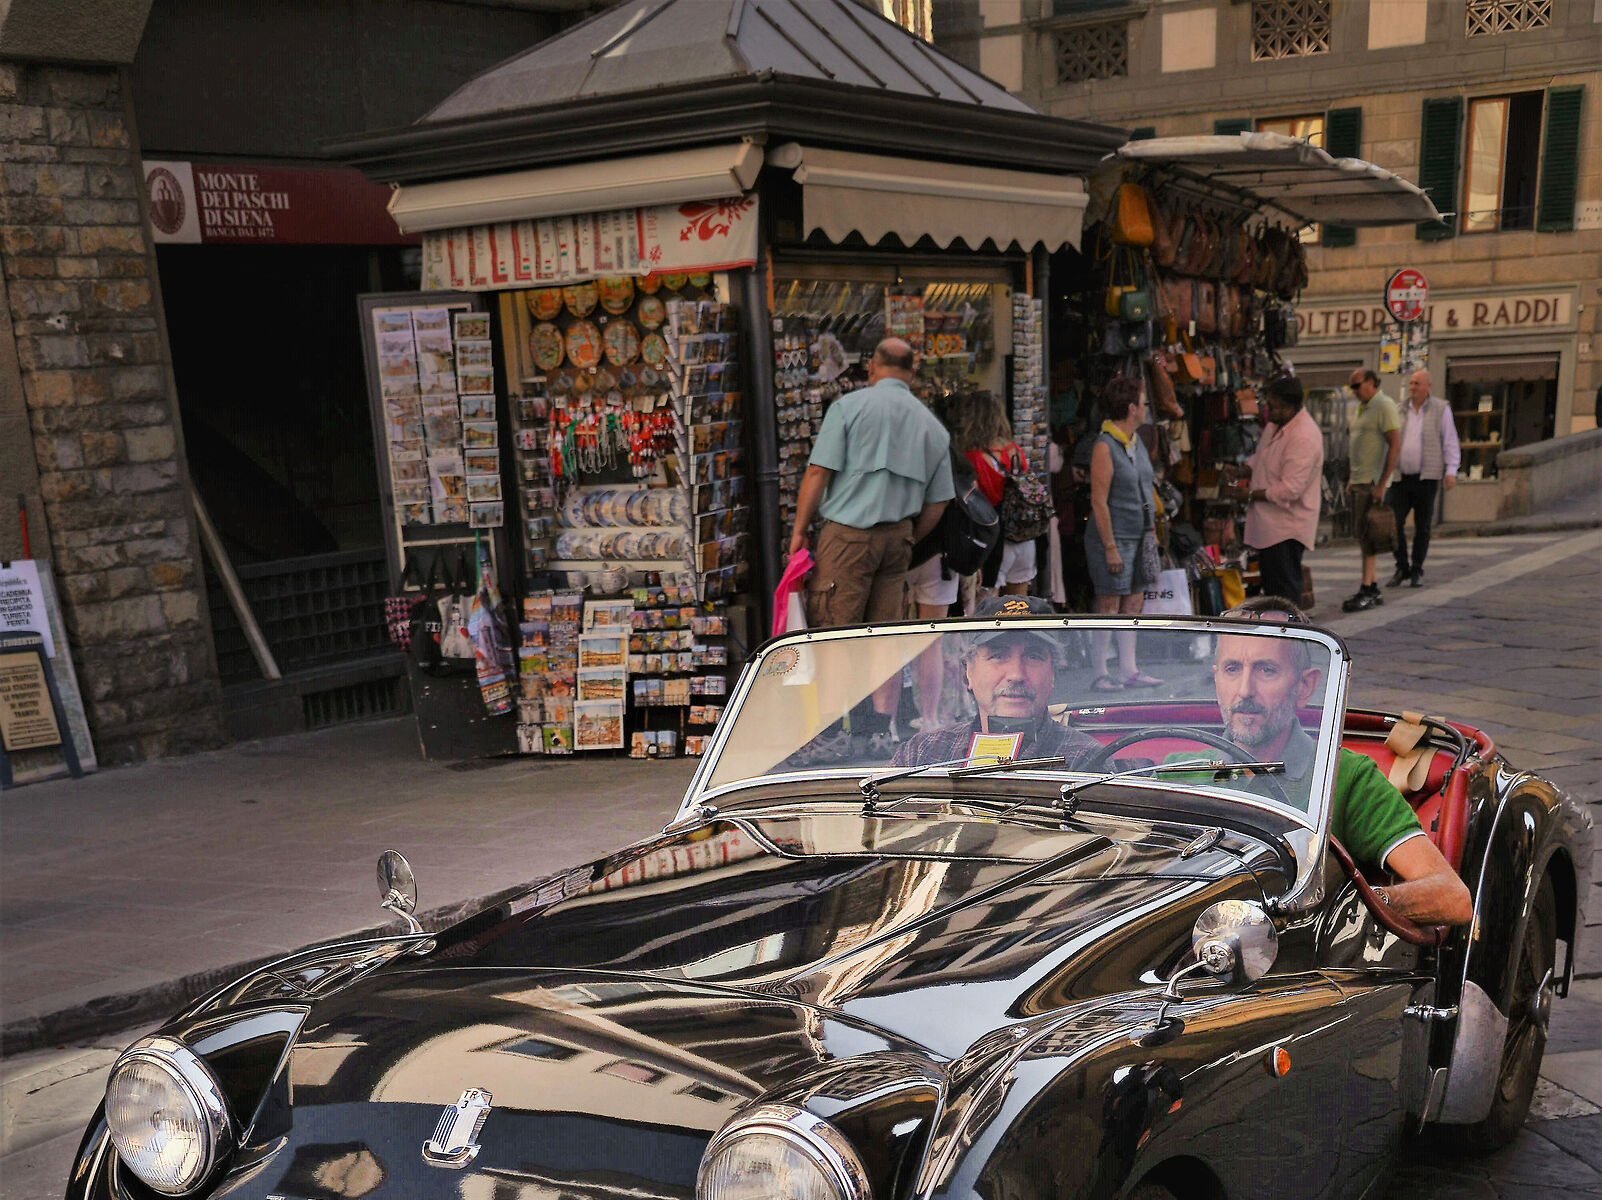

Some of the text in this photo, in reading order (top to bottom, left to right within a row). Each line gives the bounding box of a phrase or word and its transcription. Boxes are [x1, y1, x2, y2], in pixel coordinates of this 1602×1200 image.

[199, 172, 259, 190] MONTE
[201, 191, 290, 209] DEI PASCHI
[204, 209, 273, 227] DI SIENA
[206, 226, 236, 237] BANCA
[238, 227, 255, 237] DAL
[1445, 308, 1459, 327] &
[1472, 298, 1559, 326] RADDI
[463, 1090, 480, 1099] TR
[460, 1100, 469, 1109] 3
